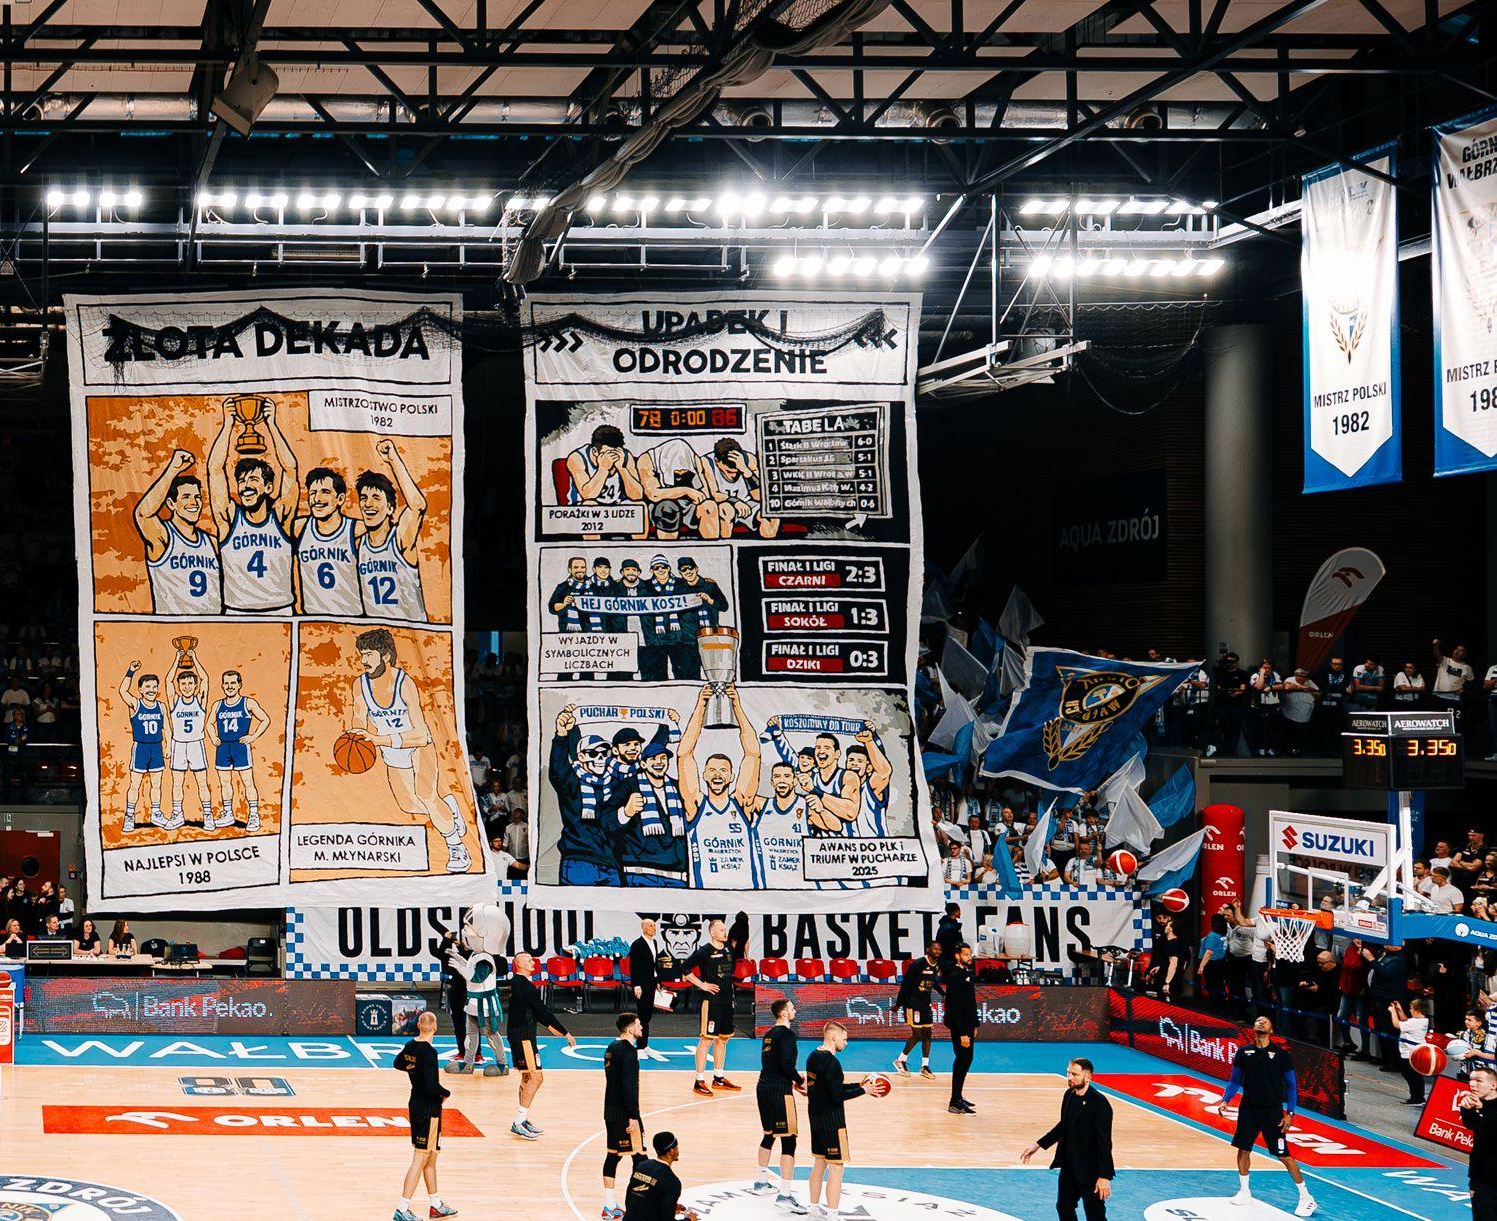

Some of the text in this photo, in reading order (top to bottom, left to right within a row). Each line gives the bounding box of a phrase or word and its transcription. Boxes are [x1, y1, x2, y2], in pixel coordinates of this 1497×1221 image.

[780, 310, 788, 335] I
[255, 320, 430, 361] DEKADA
[613, 347, 828, 375] ODRODZENIE
[1446, 360, 1490, 383] MISTRZ
[1314, 381, 1387, 409] MISTRZ POLSKI
[400, 403, 438, 415] POLSKI
[370, 415, 393, 428] 1982
[638, 410, 662, 427] 78
[670, 409, 706, 426] 0:00
[783, 416, 845, 434] TABELA
[1332, 410, 1370, 436] 1982
[769, 499, 875, 508] 10 0-6
[549, 508, 589, 519] PORAŻKI
[592, 510, 602, 519] W
[603, 509, 610, 519] 3
[581, 521, 604, 531] 2012
[1059, 508, 1160, 551] AQUA ZDRÓJ
[232, 531, 283, 550] GÓRNIK
[169, 553, 216, 570] GÓRNIK
[300, 545, 351, 564] GÓRNIK
[247, 550, 267, 578] 4
[359, 557, 399, 576] GÓRNIK
[767, 561, 835, 572] FINAŁ I LIGI
[317, 562, 335, 590] 6
[778, 565, 877, 586] CZARNI 2:3
[189, 570, 207, 598] 9
[367, 576, 399, 605] 12
[581, 596, 688, 611] HEJ GÓRNIK KOSZ!
[770, 602, 838, 613] FINAŁ I LIGI
[784, 607, 878, 627] SOKÓŁ 1:3
[558, 636, 618, 645] WYJAZDY W
[545, 649, 630, 659] SYMBOLICZNYCH
[771, 644, 839, 656] FINAŁ I LIGI
[564, 660, 614, 670] LICZBACH
[786, 650, 879, 670] DZIKI 0:3
[580, 707, 665, 719] PUCHAR POLSKI
[142, 720, 158, 735] 10
[183, 719, 193, 734] 5
[223, 718, 239, 733] 14
[385, 717, 403, 728] 12
[1351, 719, 1387, 729] AEROWATCH
[1393, 718, 1450, 729] AEROWATCH
[791, 823, 802, 833] 41
[297, 831, 416, 847] LEGENDA GÓRNIKA
[703, 836, 745, 848] GÓRNIK
[764, 836, 802, 848] GÓRNIK
[819, 842, 897, 852] AWANS DO PLK
[1301, 831, 1375, 858] SUZUKI
[124, 846, 260, 872] NAJLEPSI W POLSCE
[314, 850, 401, 863] M. MŁYNARSKI
[810, 853, 918, 864] TRIUMF W PUCHARZE
[179, 870, 211, 884] 1988
[852, 866, 878, 876] 2025
[143, 996, 197, 1018] Bank
[1190, 1025, 1226, 1062] Bank
[213, 1113, 412, 1130] ORLEN
[1429, 1121, 1453, 1142] Bank
[3, 1177, 153, 1217] ZDRÓJ
